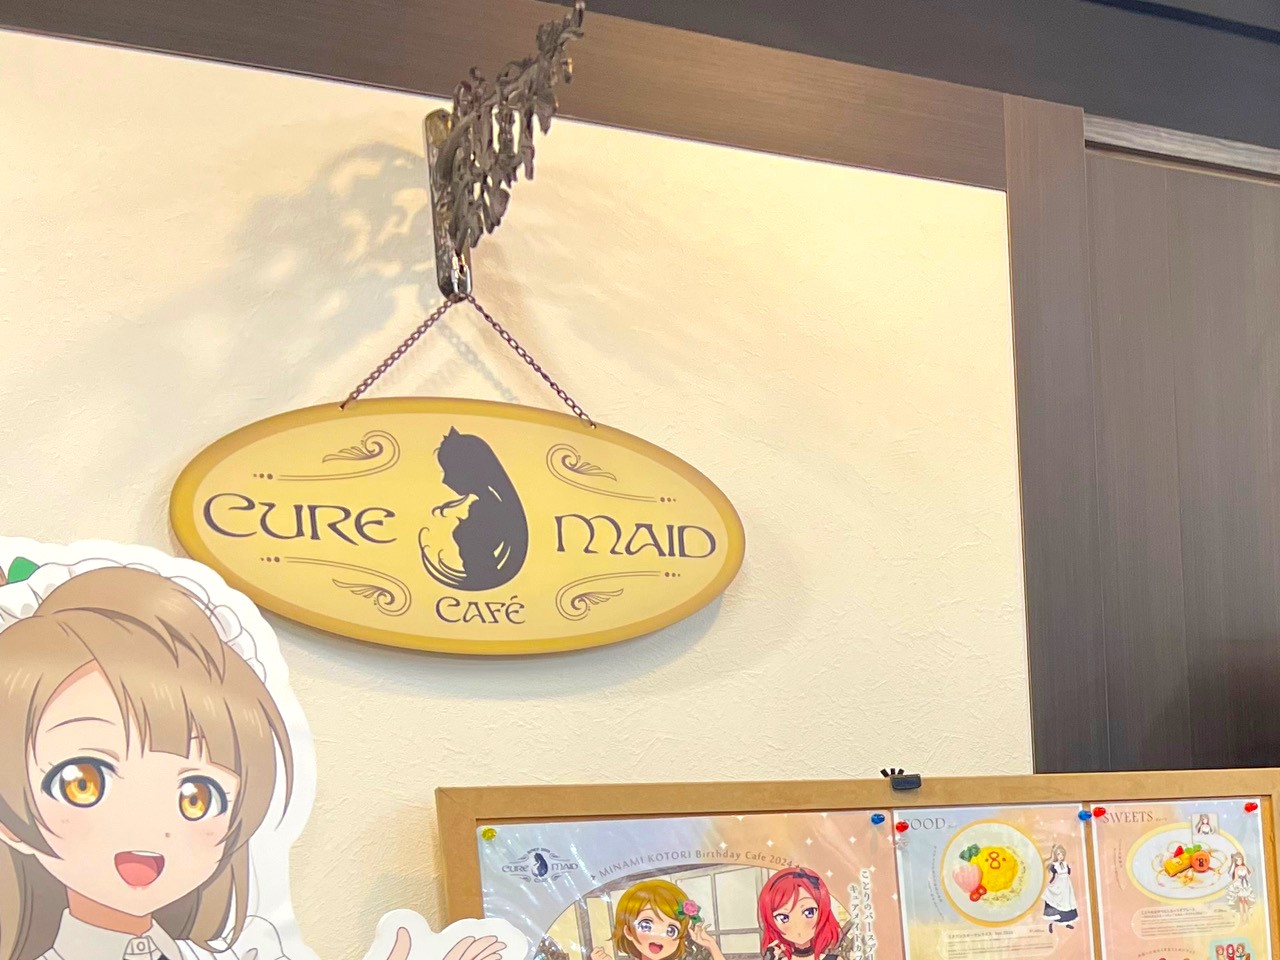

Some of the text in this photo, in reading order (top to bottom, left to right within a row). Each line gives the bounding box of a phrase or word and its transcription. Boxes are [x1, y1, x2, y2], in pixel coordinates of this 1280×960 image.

[1102, 811, 1154, 824] SWEETS
[905, 818, 946, 831] OOD
[599, 849, 793, 878] MINAMI KOTORI Birthday Cafe 2024
